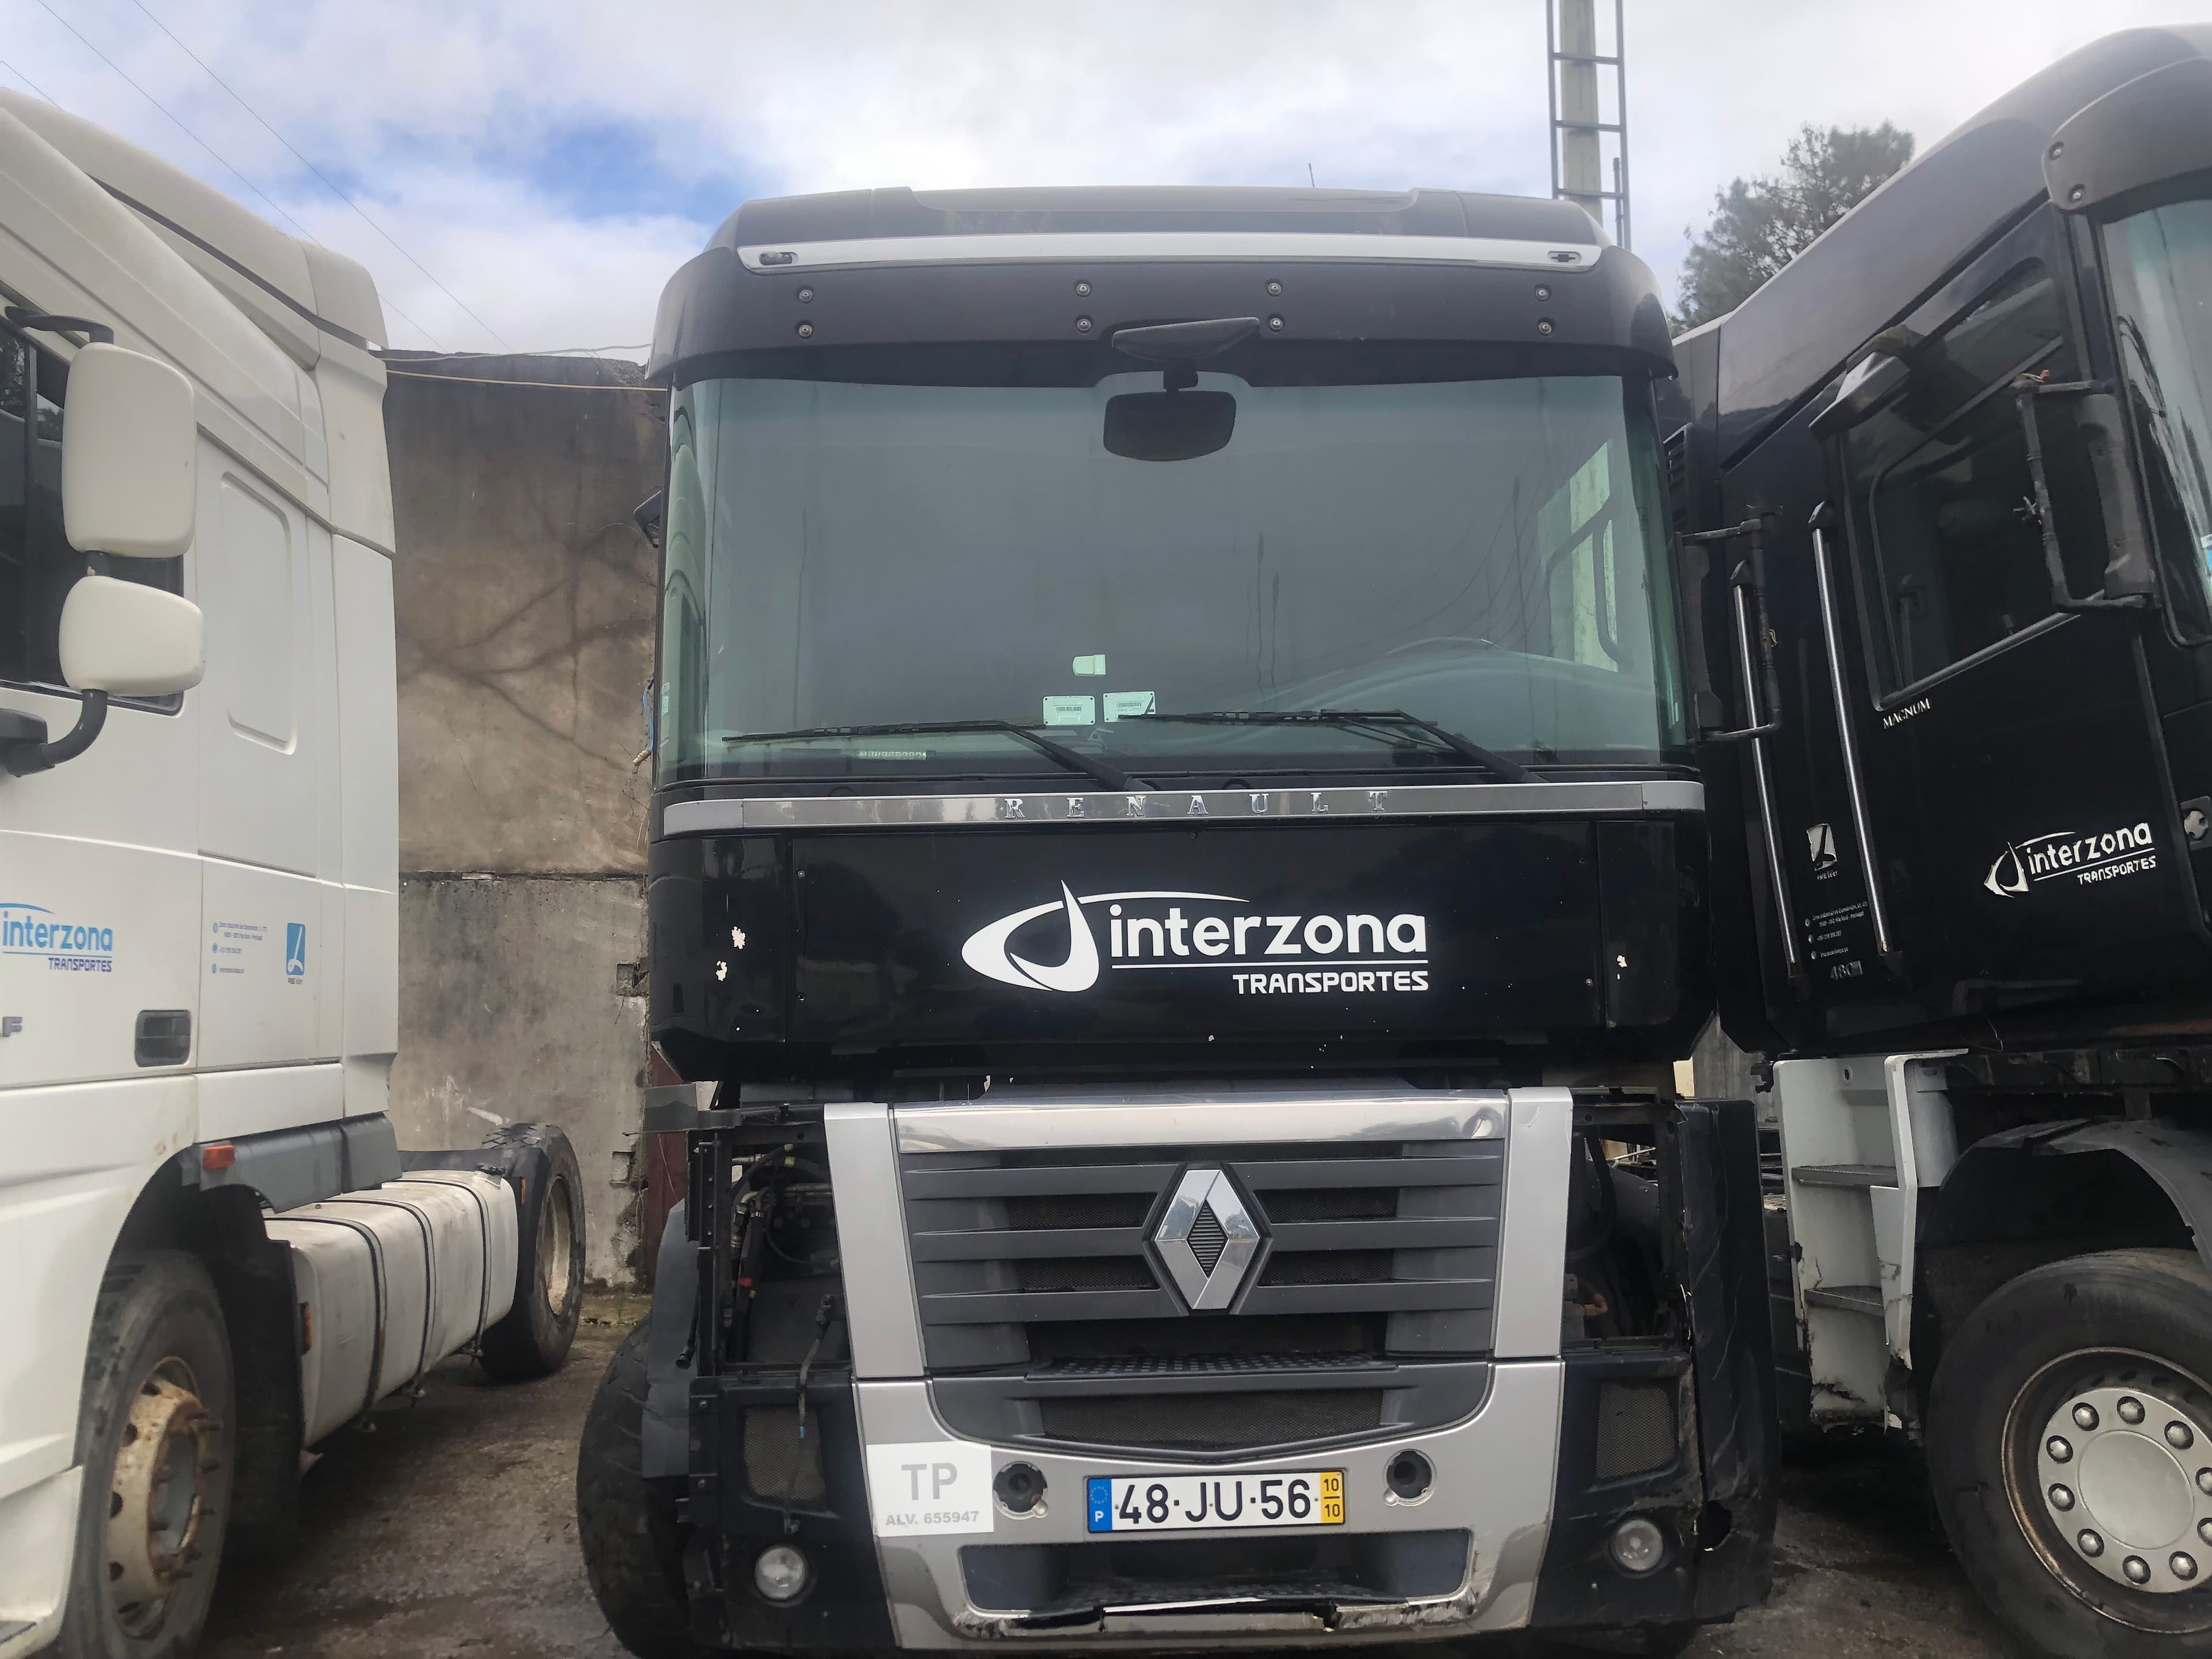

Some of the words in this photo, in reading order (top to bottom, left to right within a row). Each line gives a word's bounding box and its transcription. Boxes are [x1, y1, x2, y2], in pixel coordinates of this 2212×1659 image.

[1883, 698, 1931, 729] MAGNUM
[1003, 790, 1388, 819] RENAULT
[2027, 821, 2153, 874] interzona
[2077, 855, 2157, 885] TRANSPORTES
[2, 911, 113, 952] interzona
[1109, 904, 1429, 957] interzona
[48, 957, 112, 973] TRANSPORTES
[1232, 969, 1429, 995] TRANSPORTES
[902, 1463, 958, 1501] TP
[1323, 1478, 1339, 1493] 10
[885, 1513, 919, 1526] ALV.
[923, 1510, 979, 1525] 655947
[1095, 1510, 1105, 1523] P
[1324, 1503, 1342, 1518] 10
